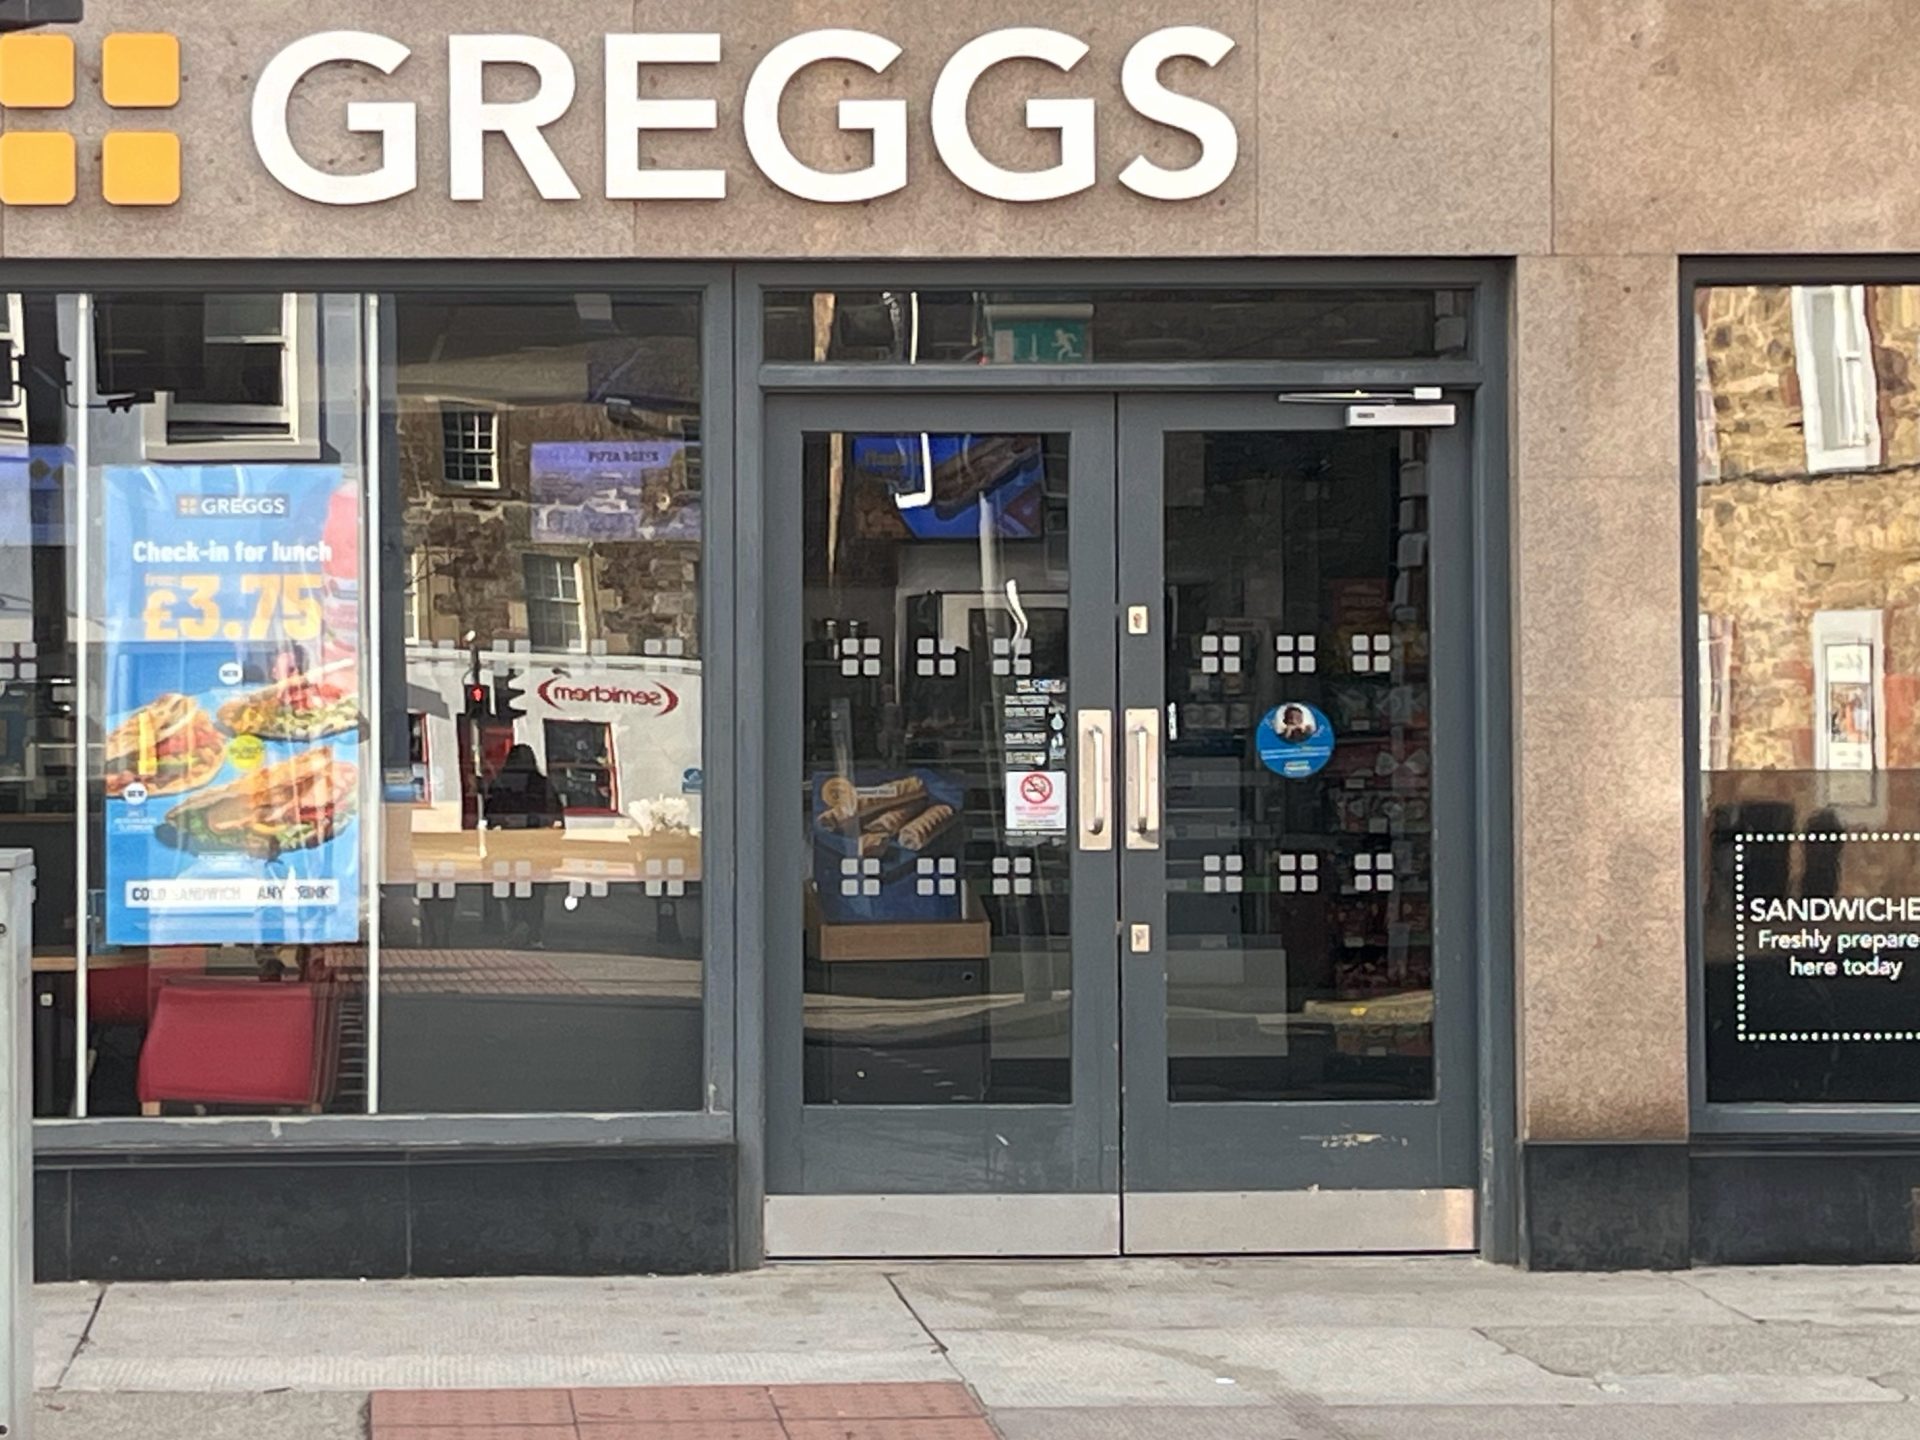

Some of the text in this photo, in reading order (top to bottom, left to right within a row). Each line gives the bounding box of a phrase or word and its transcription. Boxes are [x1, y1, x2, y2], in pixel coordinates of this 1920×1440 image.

[251, 26, 1238, 205] GREGGS
[201, 498, 285, 514] GREGGS
[132, 540, 333, 563] Check-in for lunch
[143, 573, 323, 641] £3.75
[131, 886, 167, 901] COLD
[257, 886, 284, 900] ANY
[1750, 898, 1920, 922] SANDWICHE
[1758, 929, 1920, 954] Freshly prepare
[1790, 955, 1903, 981] here today
